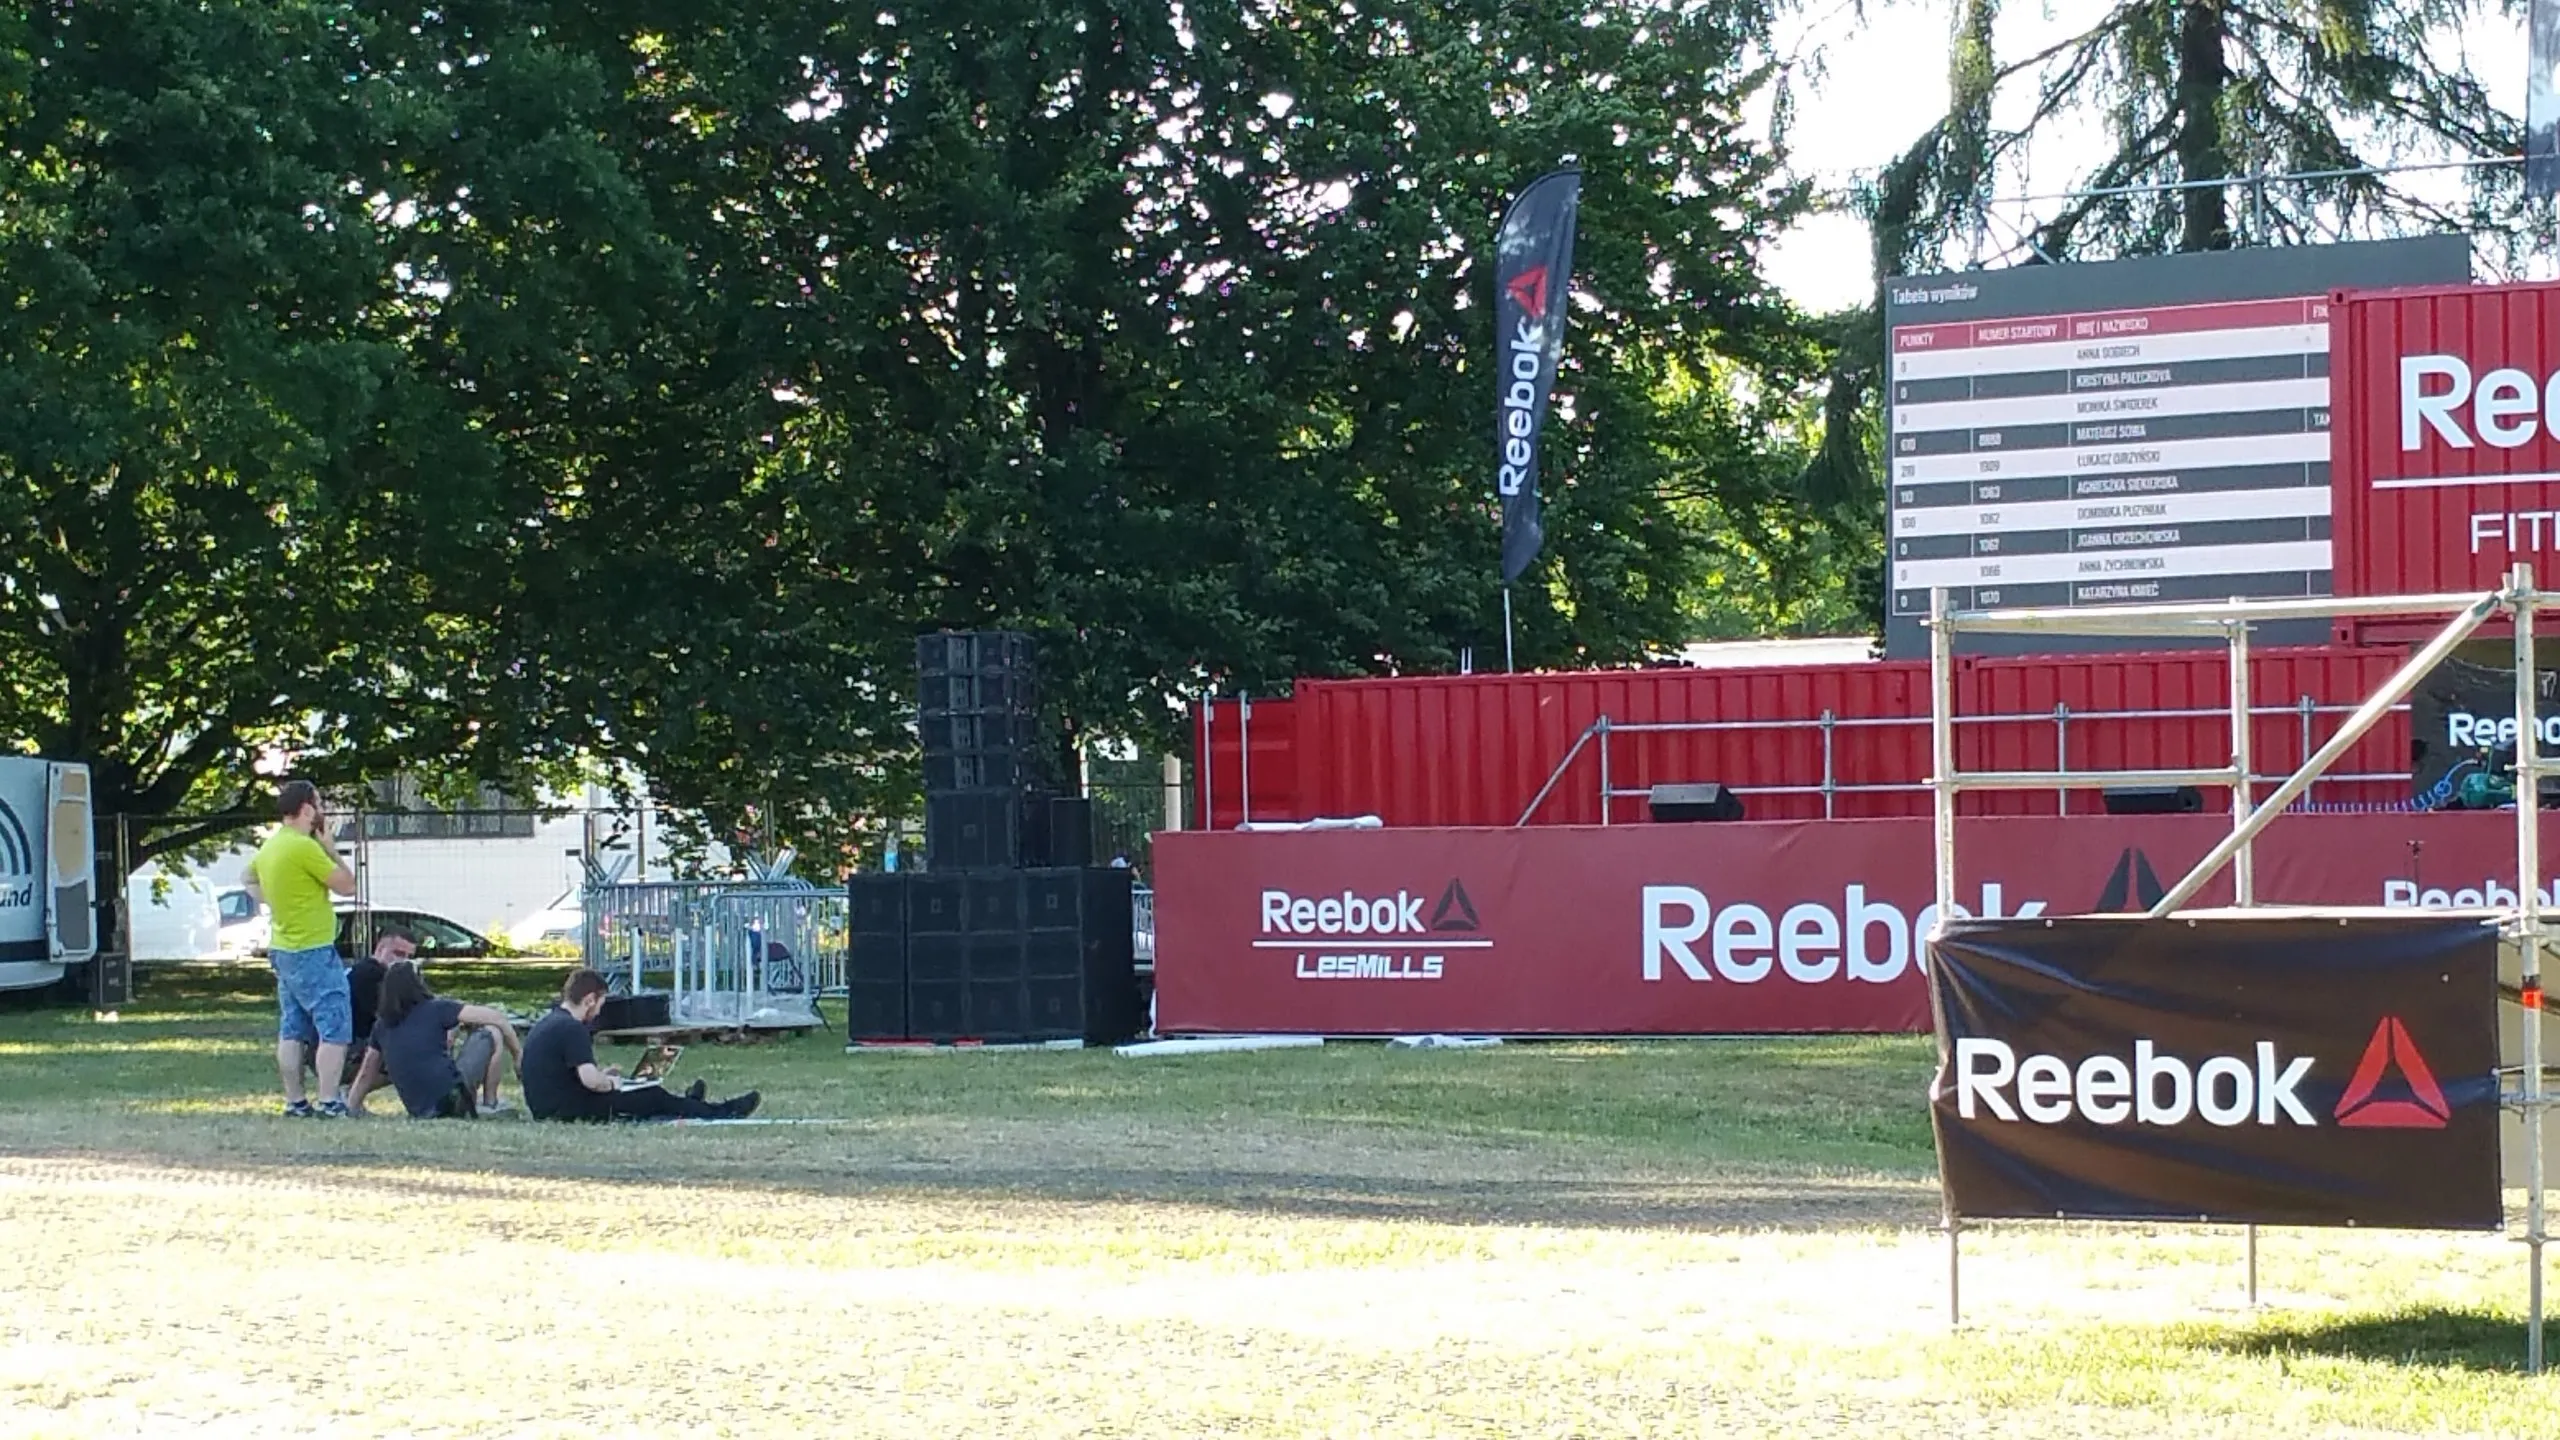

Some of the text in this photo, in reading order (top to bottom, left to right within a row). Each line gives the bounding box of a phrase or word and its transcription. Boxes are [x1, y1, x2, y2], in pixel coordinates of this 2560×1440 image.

[1892, 288, 1928, 304] Tabela
[1500, 314, 1543, 496] Reebok
[2401, 355, 2560, 450] Re
[2471, 512, 2560, 553] FIT
[1262, 890, 1427, 934] Reebok
[1955, 1037, 2318, 1126] Reebok
